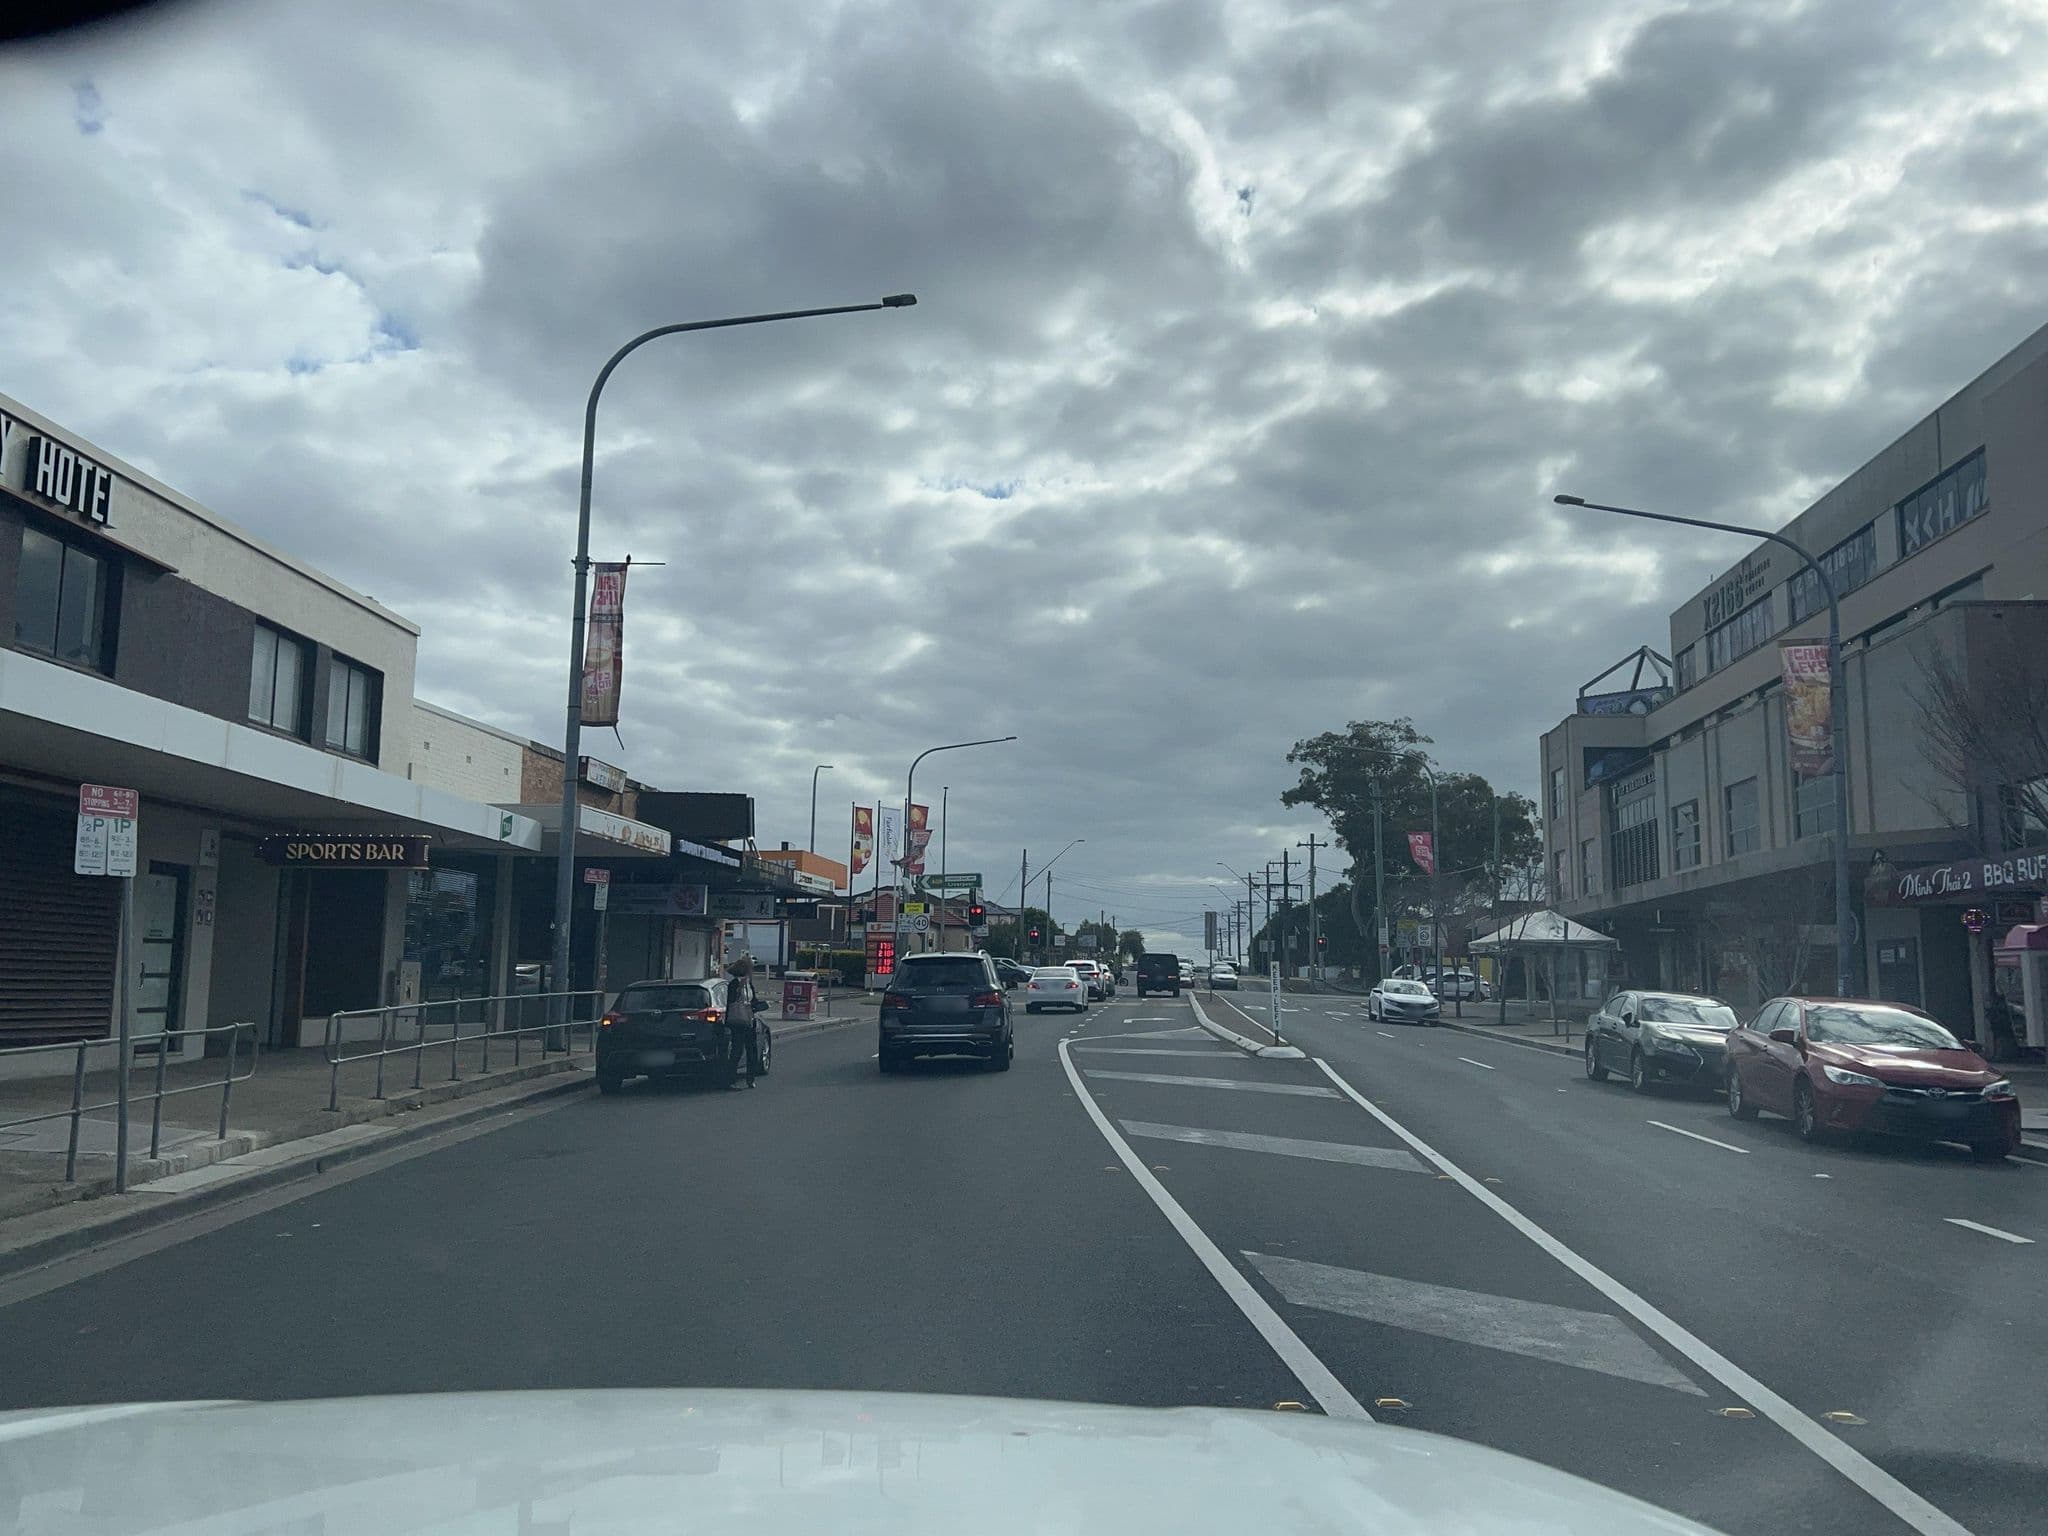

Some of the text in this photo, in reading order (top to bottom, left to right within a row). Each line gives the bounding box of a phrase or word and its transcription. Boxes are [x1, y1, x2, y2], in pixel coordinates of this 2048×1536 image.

[91, 787, 104, 798] NO
[286, 843, 404, 860] SPORTS BAR
[1898, 873, 1933, 899] Minh
[1962, 871, 1973, 890] 2
[1983, 861, 2015, 886] BBQ
[915, 919, 927, 927] 40
